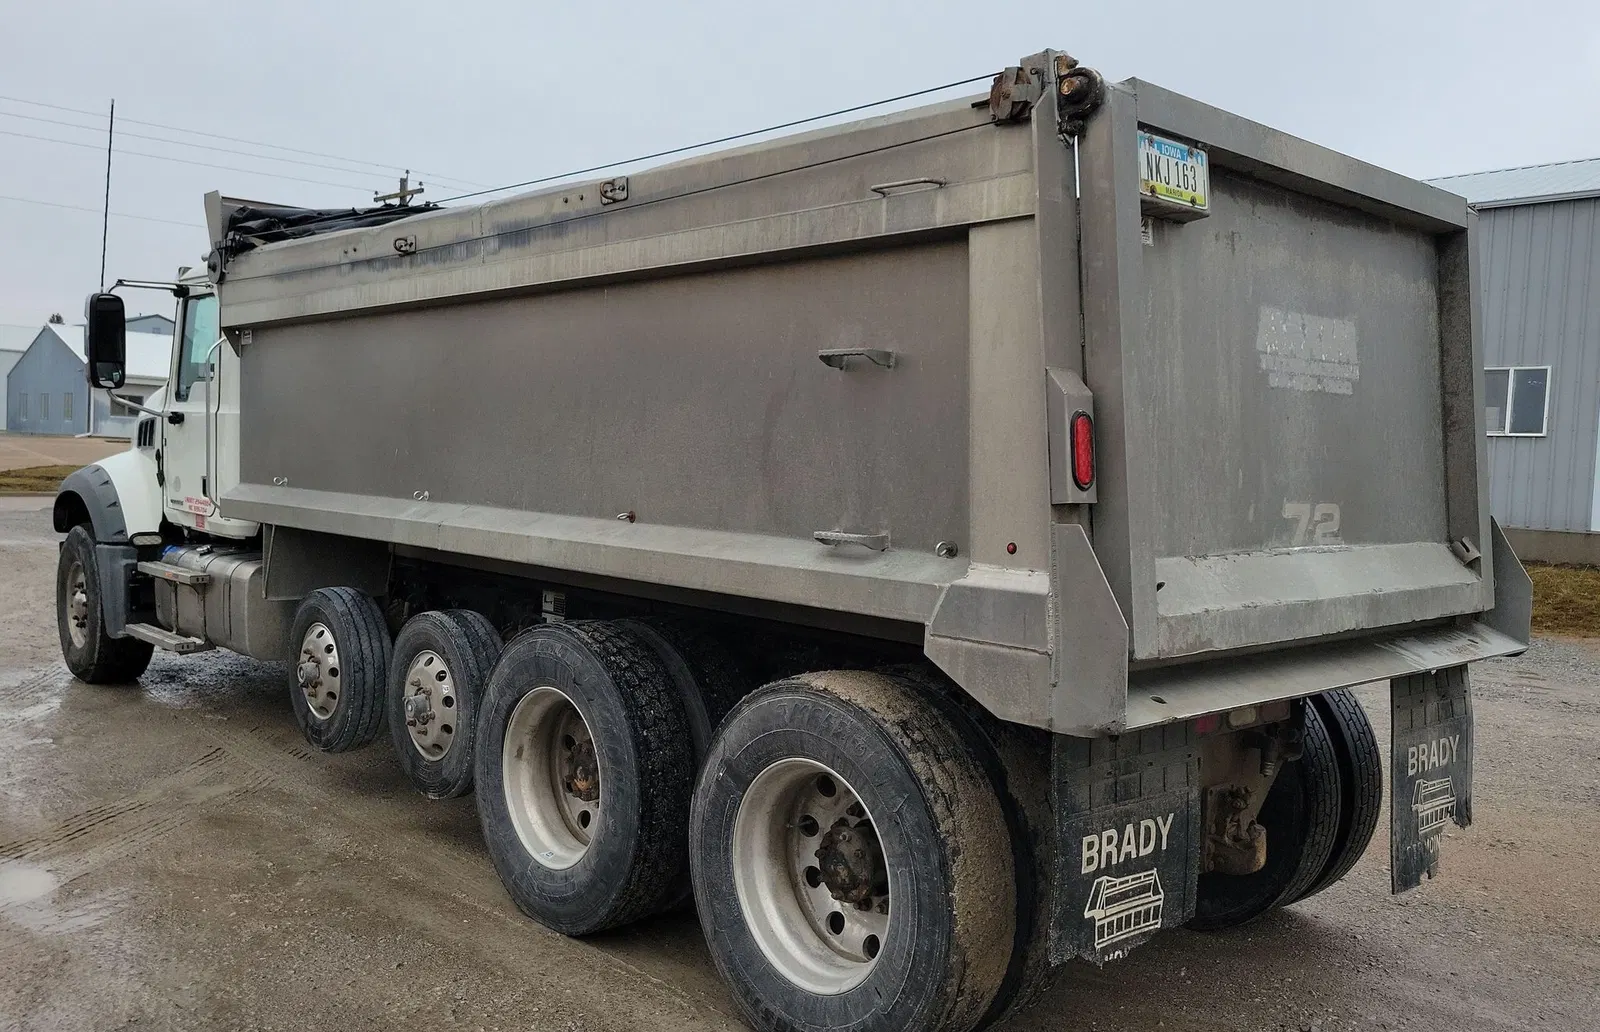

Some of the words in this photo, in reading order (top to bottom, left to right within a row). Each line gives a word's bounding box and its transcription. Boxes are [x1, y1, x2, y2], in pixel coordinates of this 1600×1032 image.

[1161, 144, 1181, 158] IOWA
[1146, 152, 1170, 186] NKJ
[1175, 160, 1197, 193] 163
[1165, 187, 1183, 198] MARION
[1283, 503, 1344, 546] 72
[1407, 734, 1460, 778] BRADY
[1081, 812, 1175, 875] BRADY
